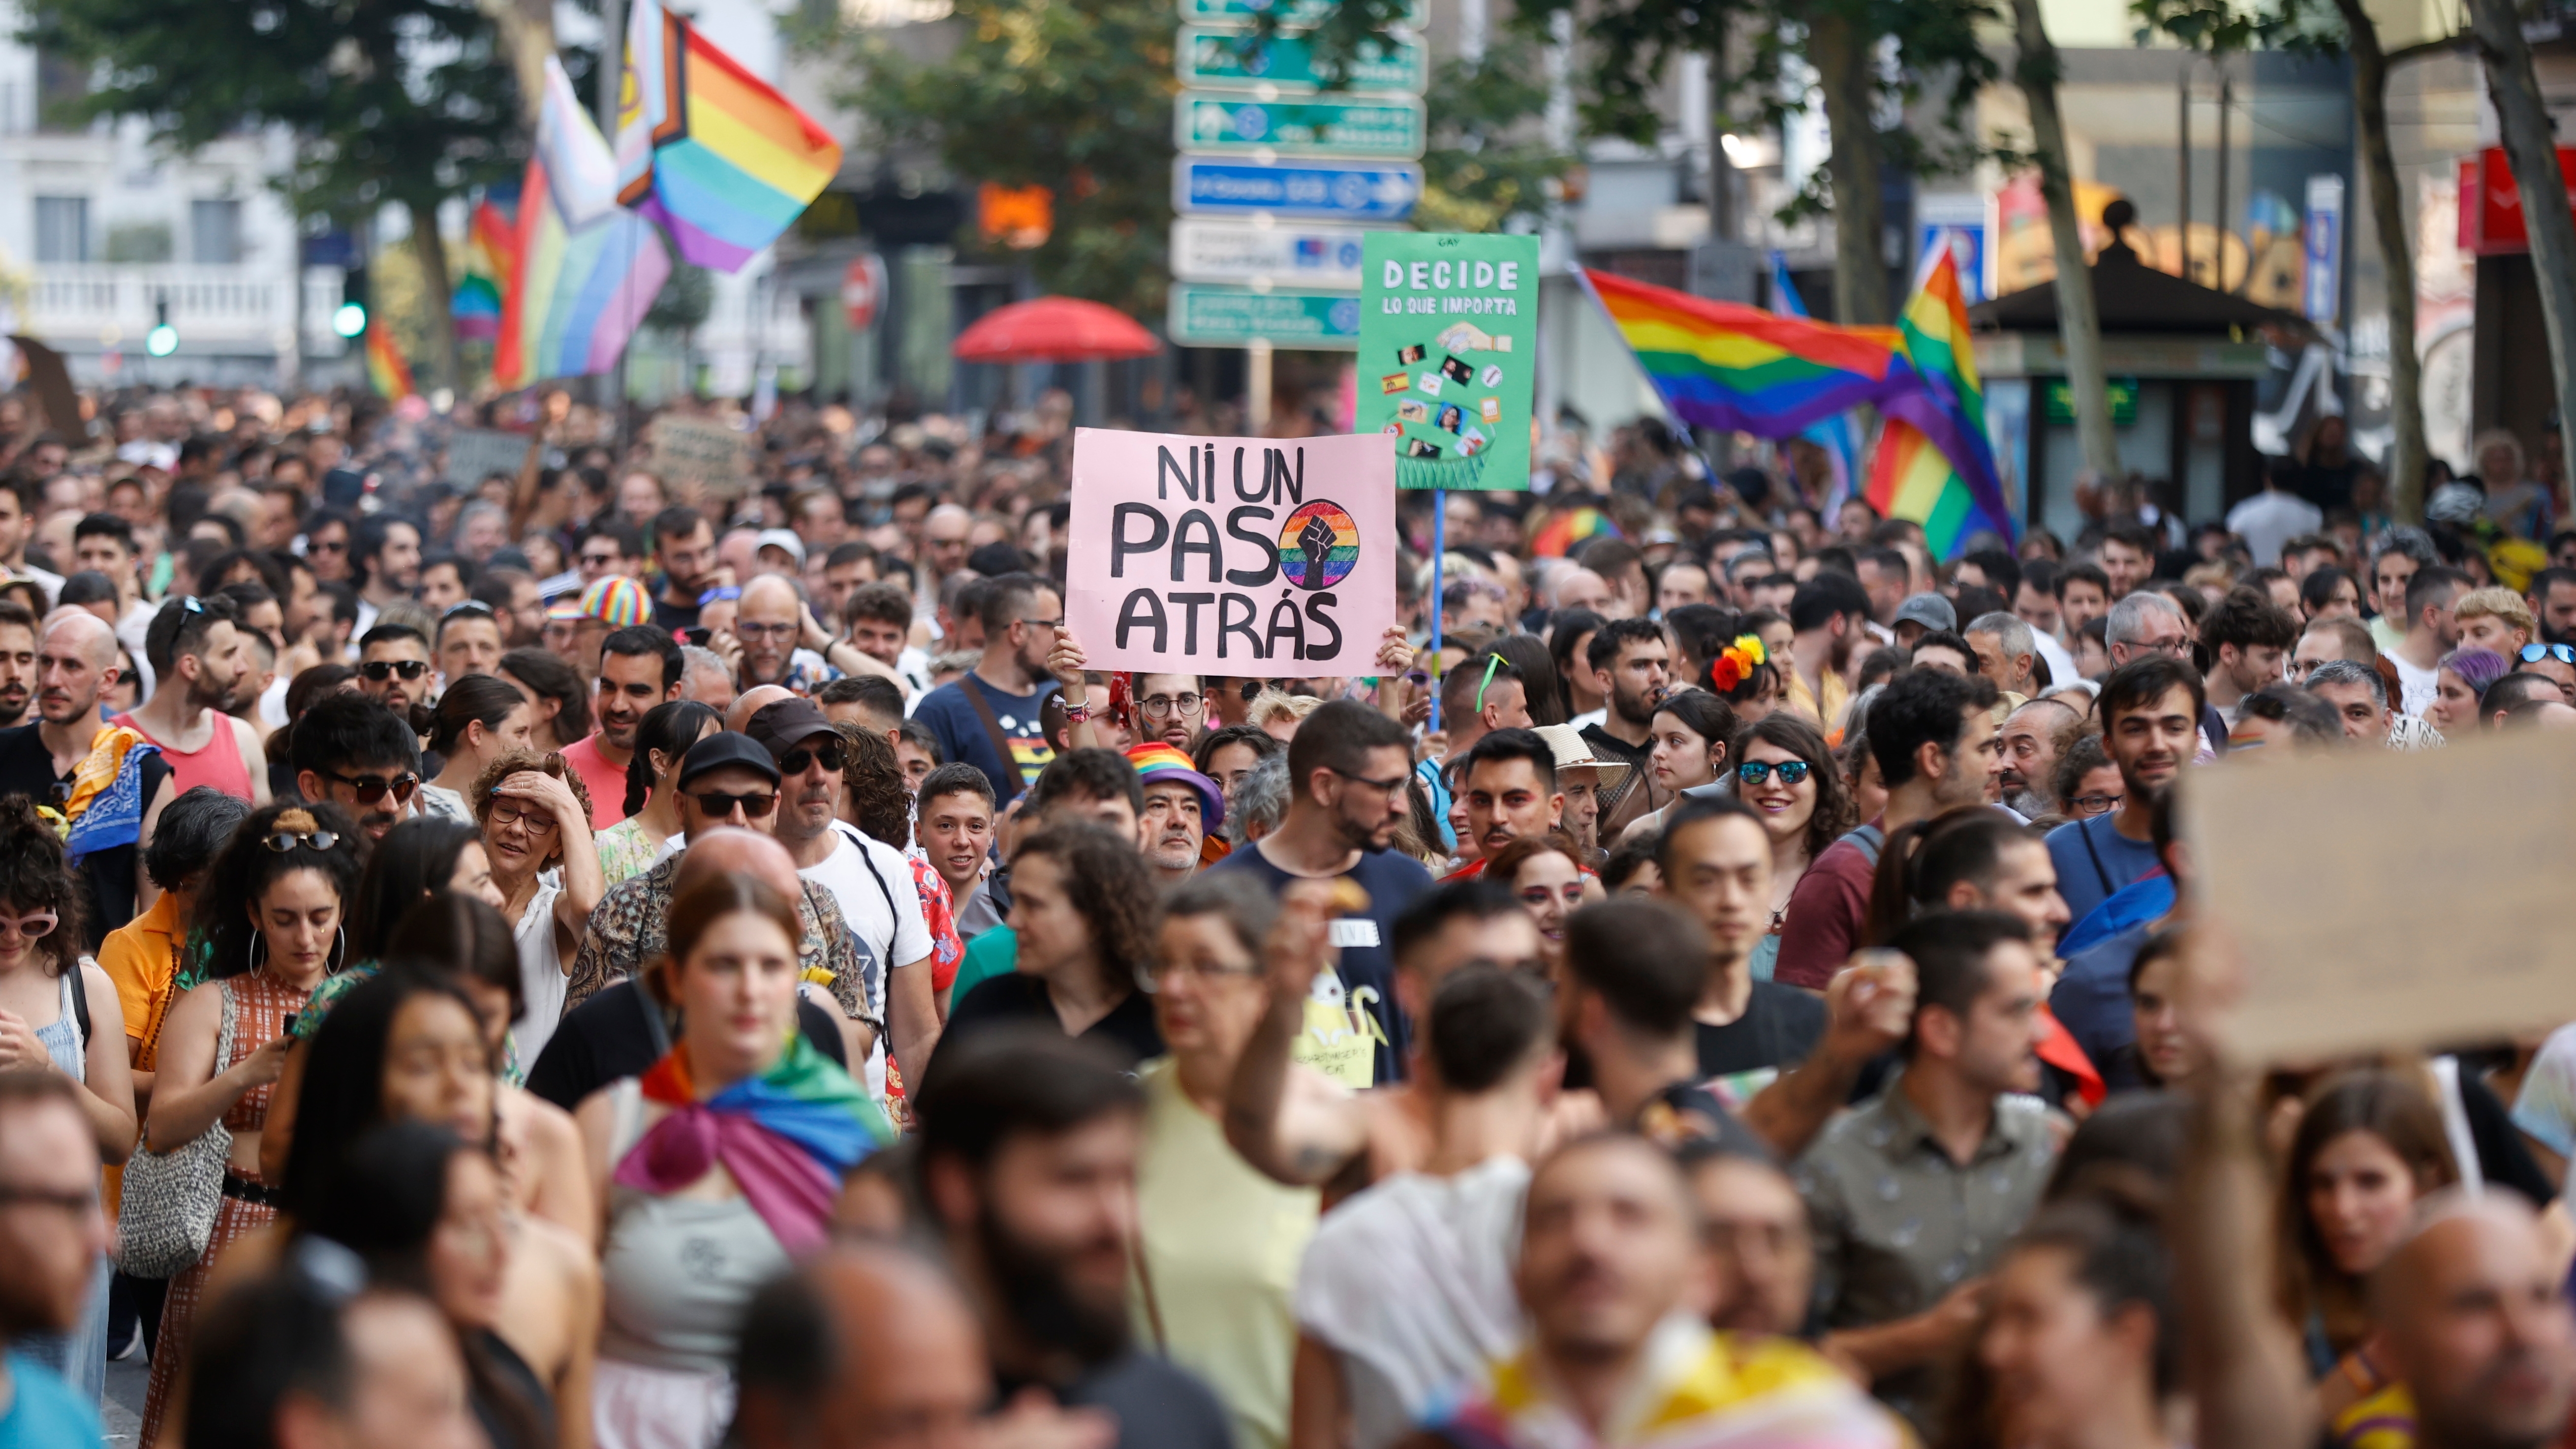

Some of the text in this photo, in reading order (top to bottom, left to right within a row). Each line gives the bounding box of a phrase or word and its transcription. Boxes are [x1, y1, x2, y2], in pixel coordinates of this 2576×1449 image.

[1438, 238, 1460, 247] GAY
[1384, 259, 1519, 291] DECIDE
[1383, 296, 1517, 316] LO QUE IMPORTA
[1233, 446, 1304, 505] UN
[1115, 588, 1342, 661] ATRÁS
[1325, 1064, 1345, 1076] CAT
